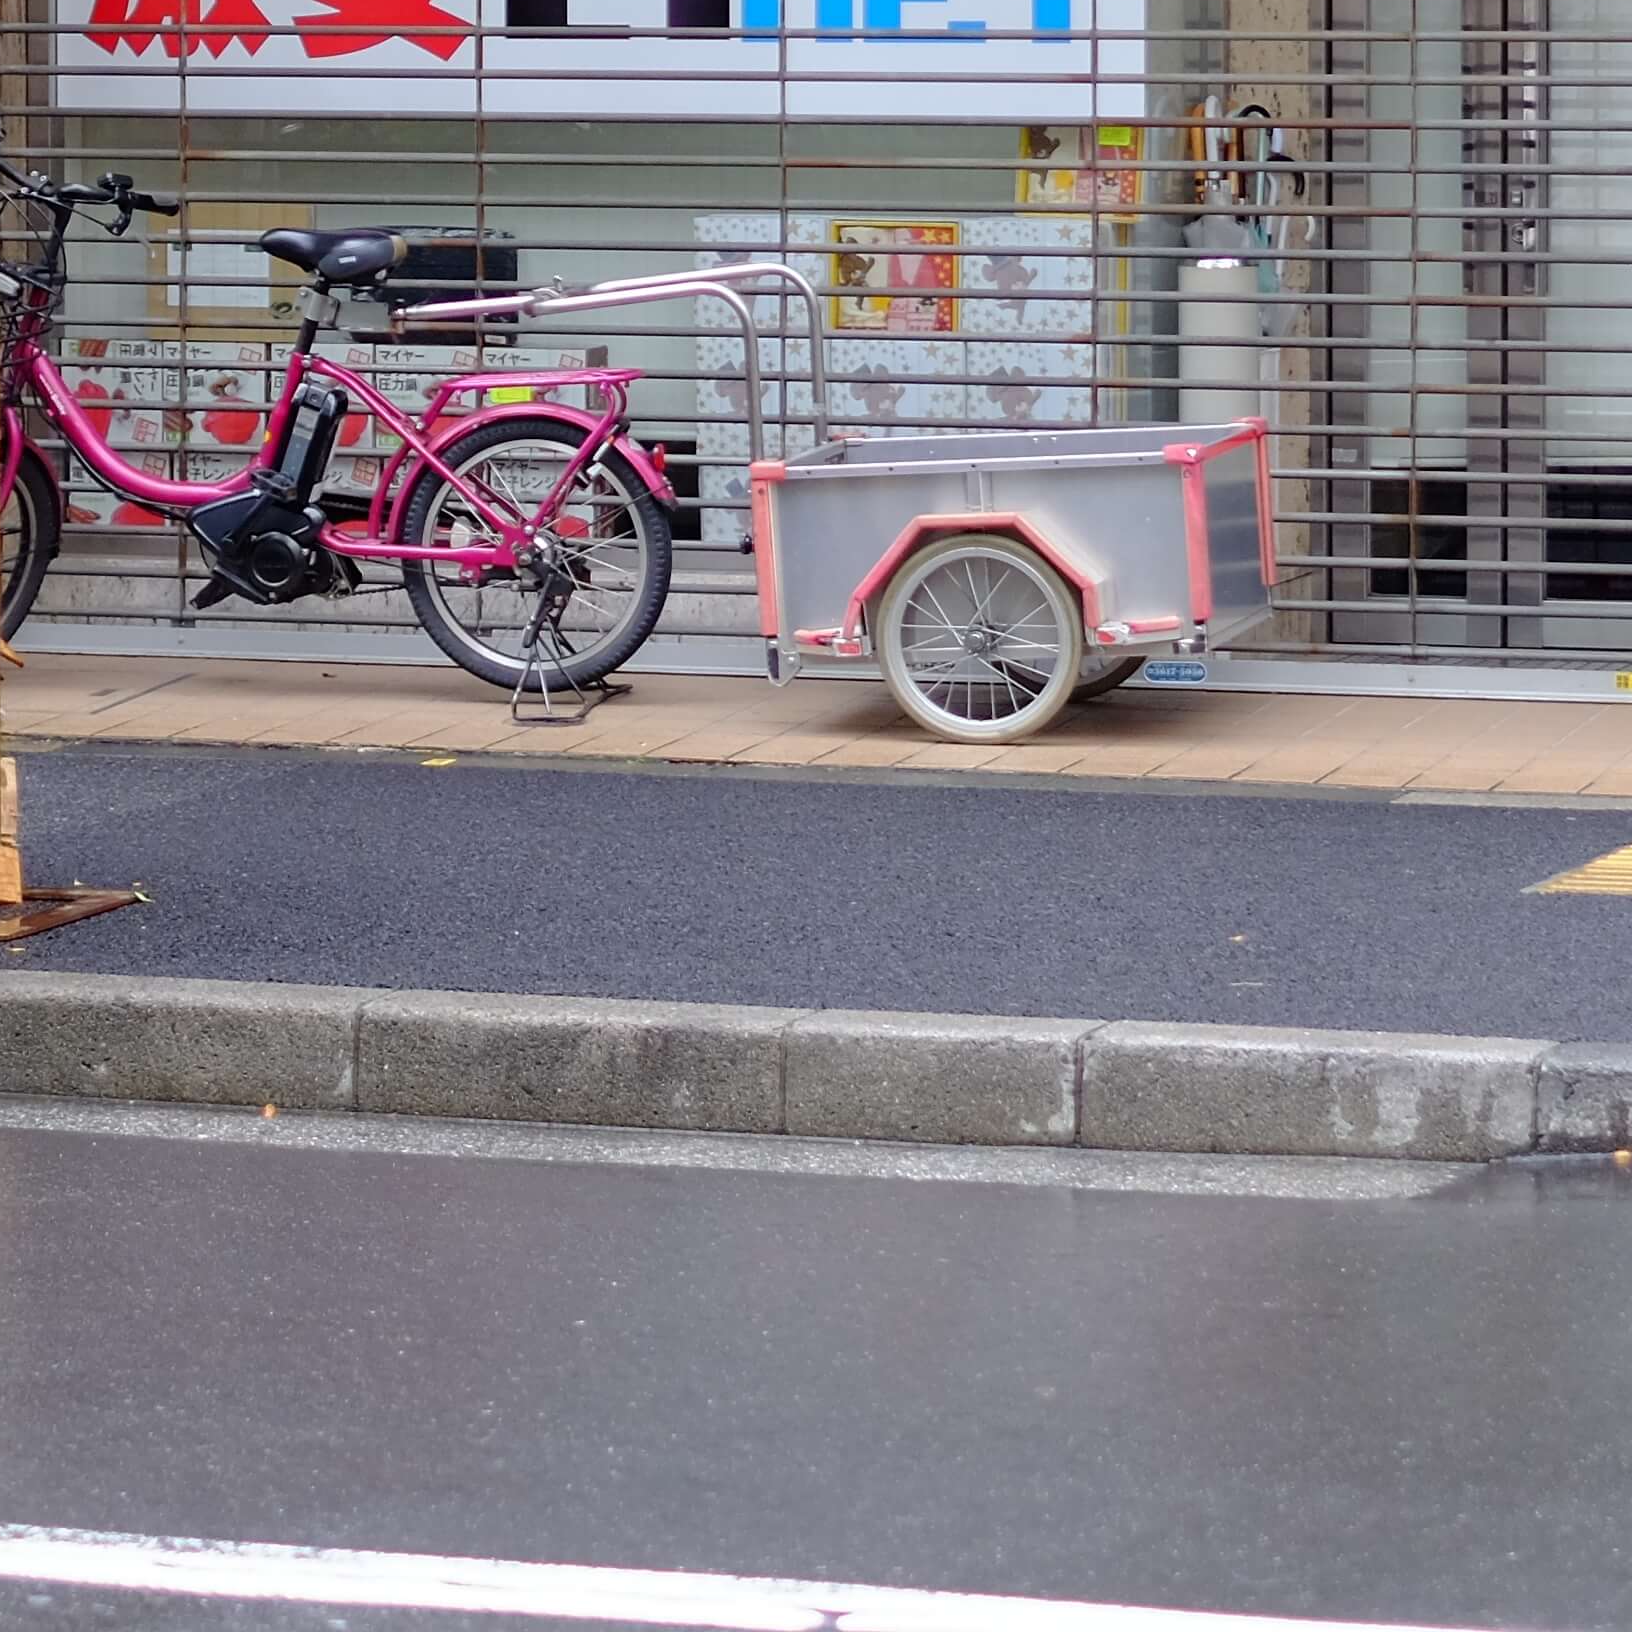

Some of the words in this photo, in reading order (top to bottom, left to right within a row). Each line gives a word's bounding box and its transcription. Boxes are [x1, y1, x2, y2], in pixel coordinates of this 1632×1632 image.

[166, 346, 212, 359] マヤー
[378, 349, 425, 363] マイヤー
[484, 352, 532, 367] マイヤー
[378, 377, 418, 391] 圧力鍋
